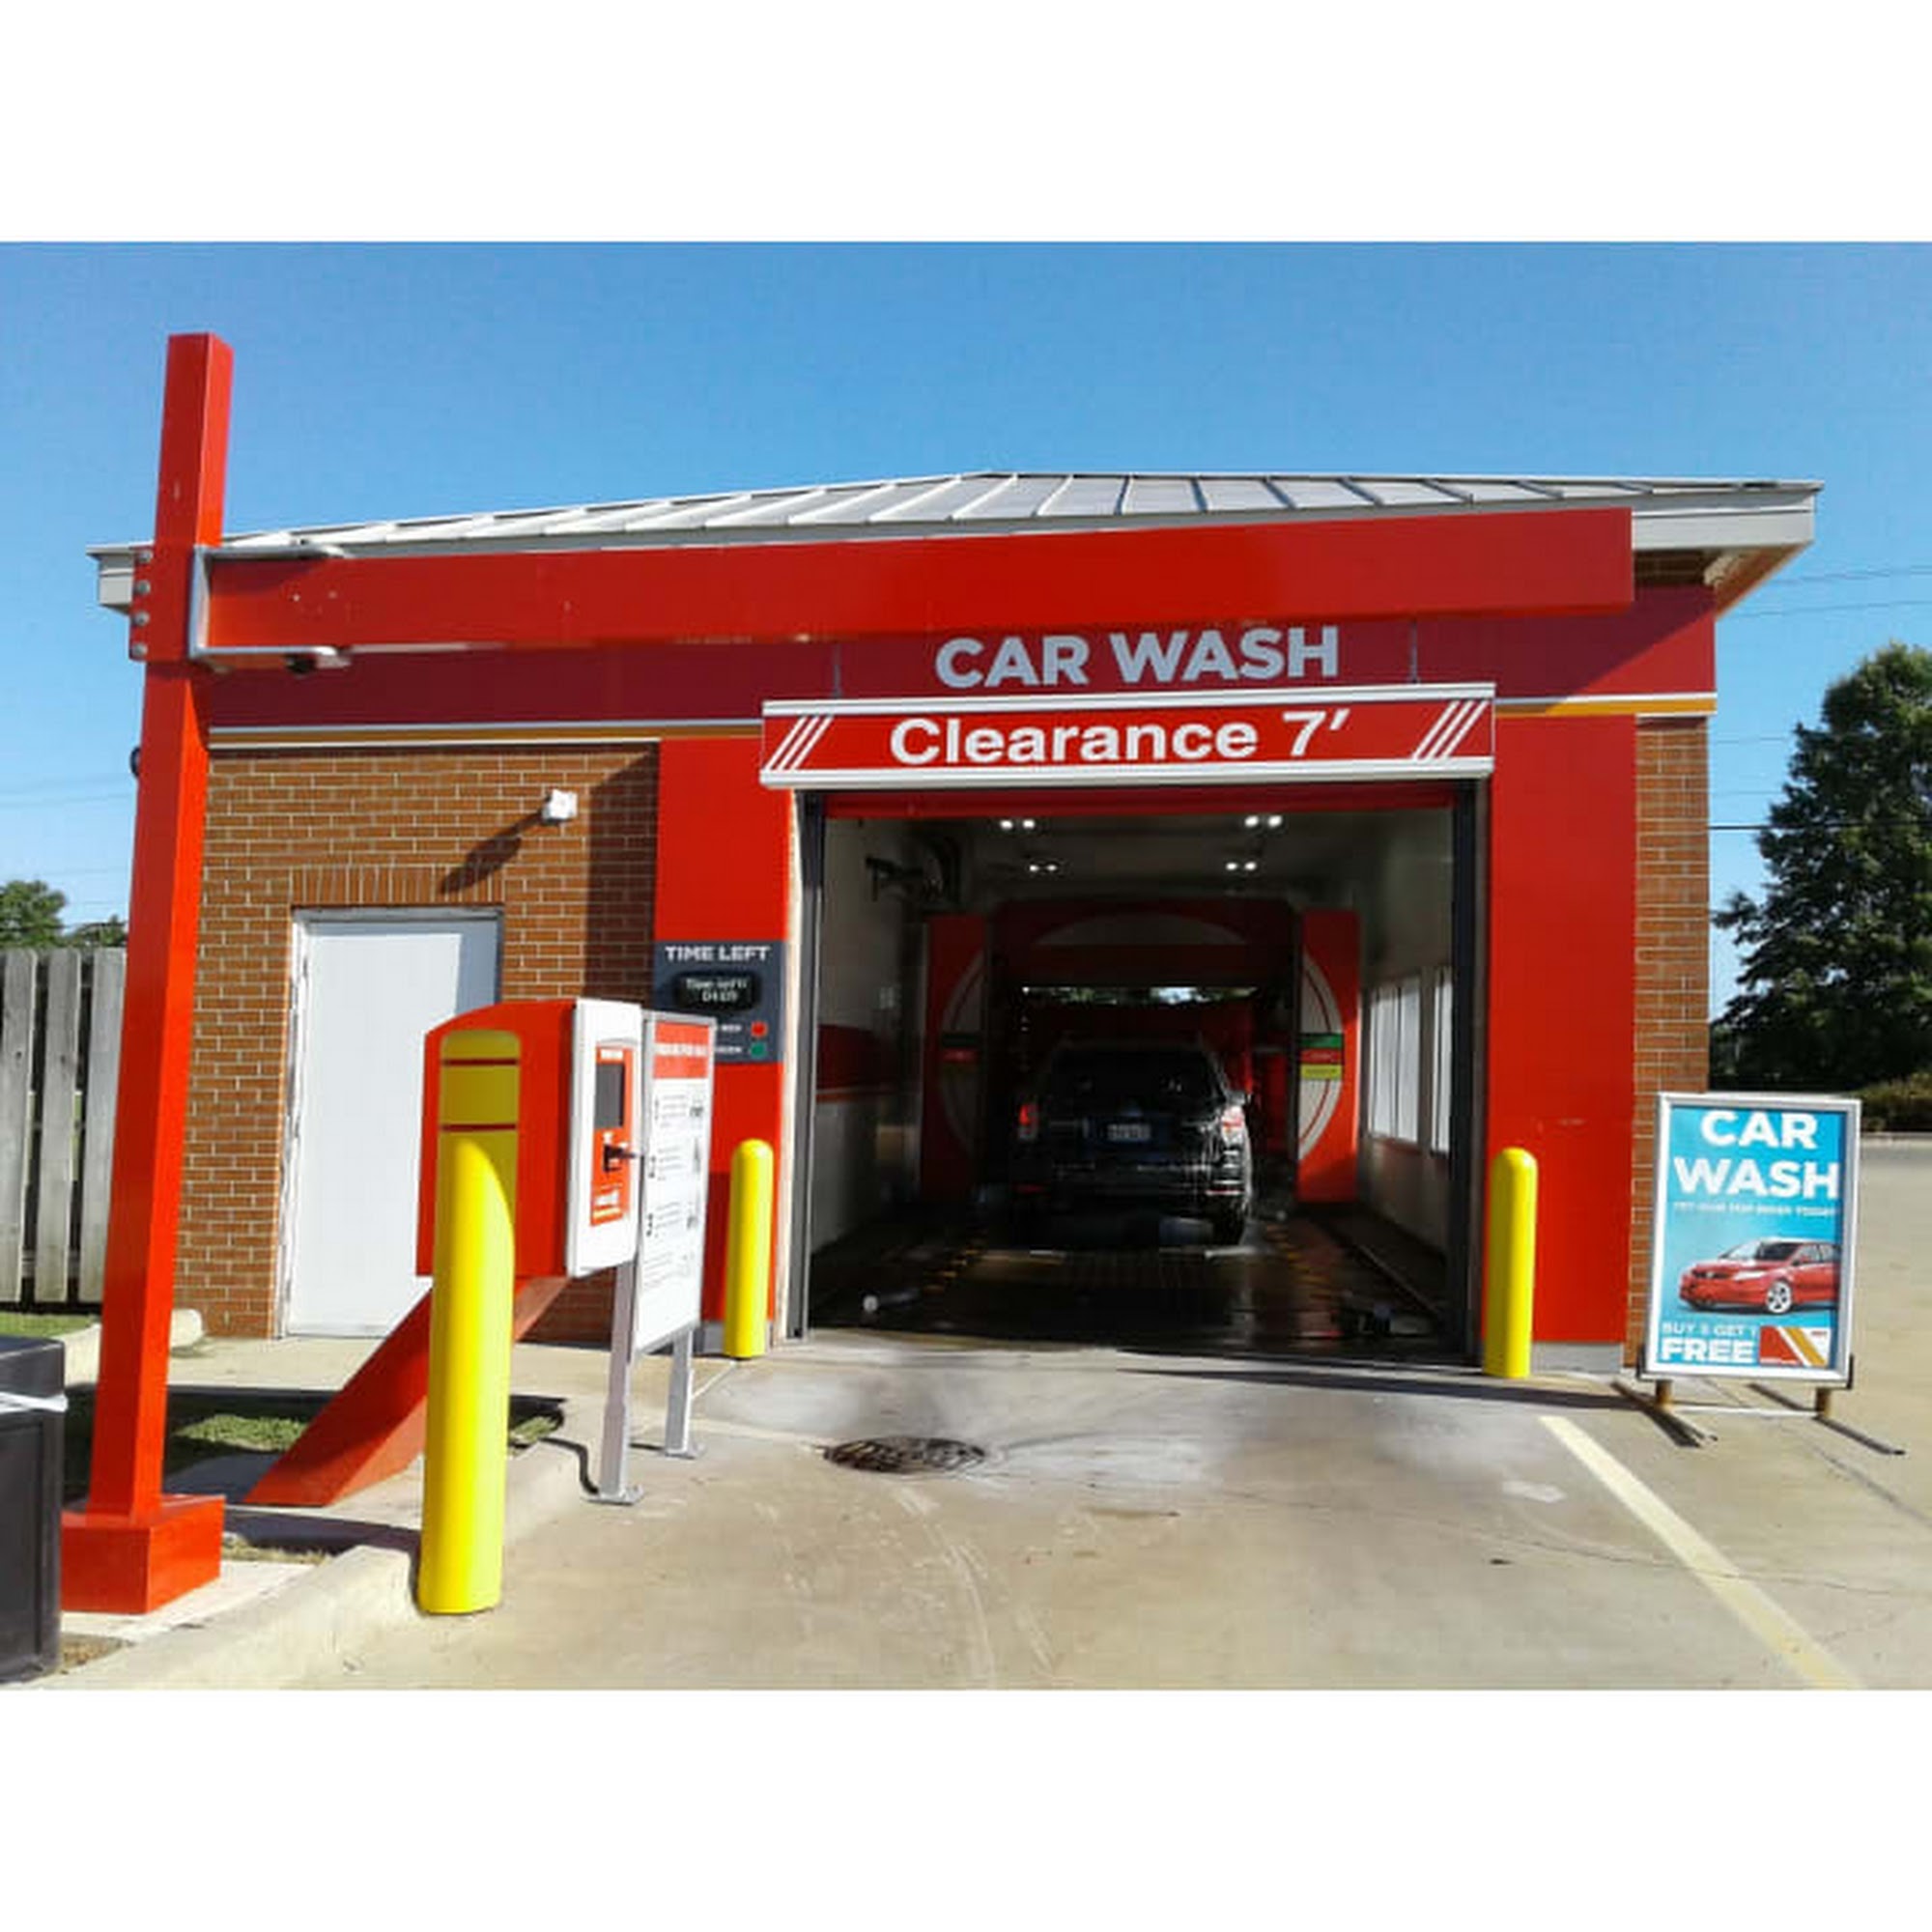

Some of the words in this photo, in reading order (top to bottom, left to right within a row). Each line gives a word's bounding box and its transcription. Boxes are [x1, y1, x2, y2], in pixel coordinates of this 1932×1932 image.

[936, 635, 1089, 688] CAR
[1110, 626, 1339, 683] WASH
[890, 718, 1258, 763] Clearance
[1283, 708, 1350, 757] 7'
[665, 945, 713, 961] TIME
[719, 945, 771, 961] LEFT
[1699, 1109, 1817, 1149] CAR
[1673, 1156, 1839, 1200] WASH
[1662, 1321, 1695, 1335] BUY
[1714, 1324, 1744, 1337] GET
[1661, 1336, 1754, 1363] FREE
